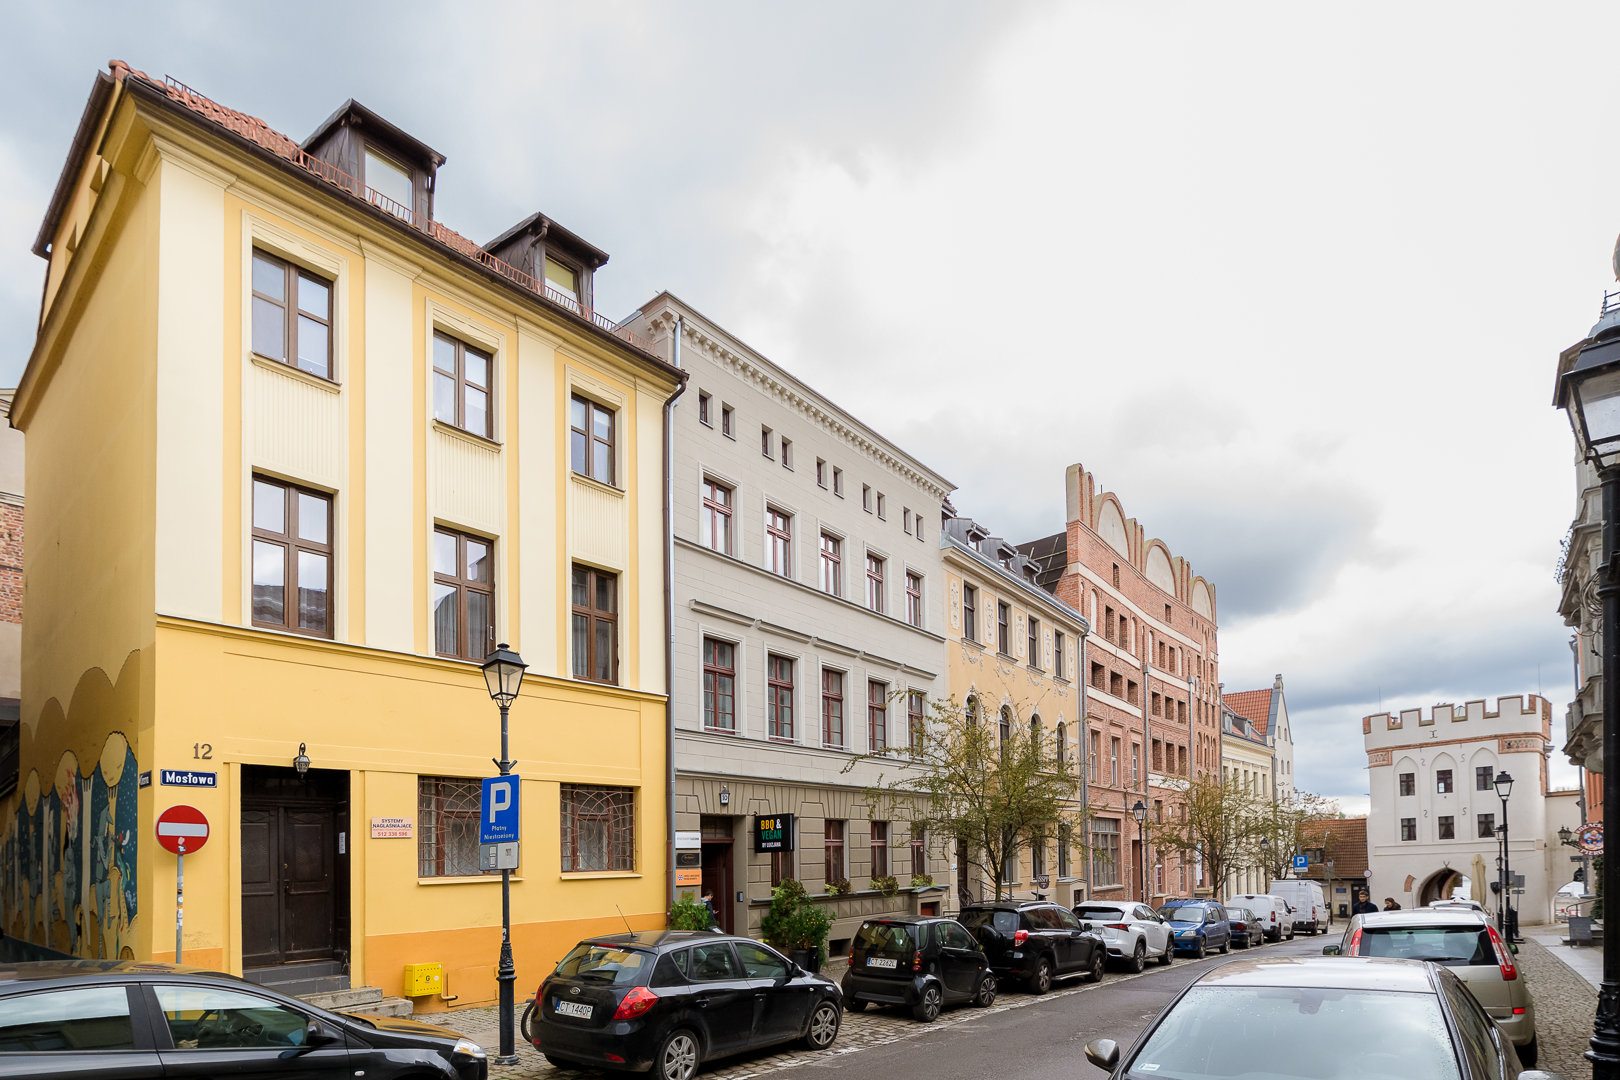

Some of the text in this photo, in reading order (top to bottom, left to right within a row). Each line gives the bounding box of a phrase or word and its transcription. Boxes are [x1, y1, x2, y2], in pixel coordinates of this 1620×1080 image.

[193, 743, 212, 760] 12
[165, 771, 213, 785] Mostowa
[489, 781, 511, 823] P
[760, 818, 782, 830] BBQ &
[761, 830, 782, 840] VEGAN
[1296, 856, 1305, 866] P
[560, 1002, 592, 1016] CT 1440P
